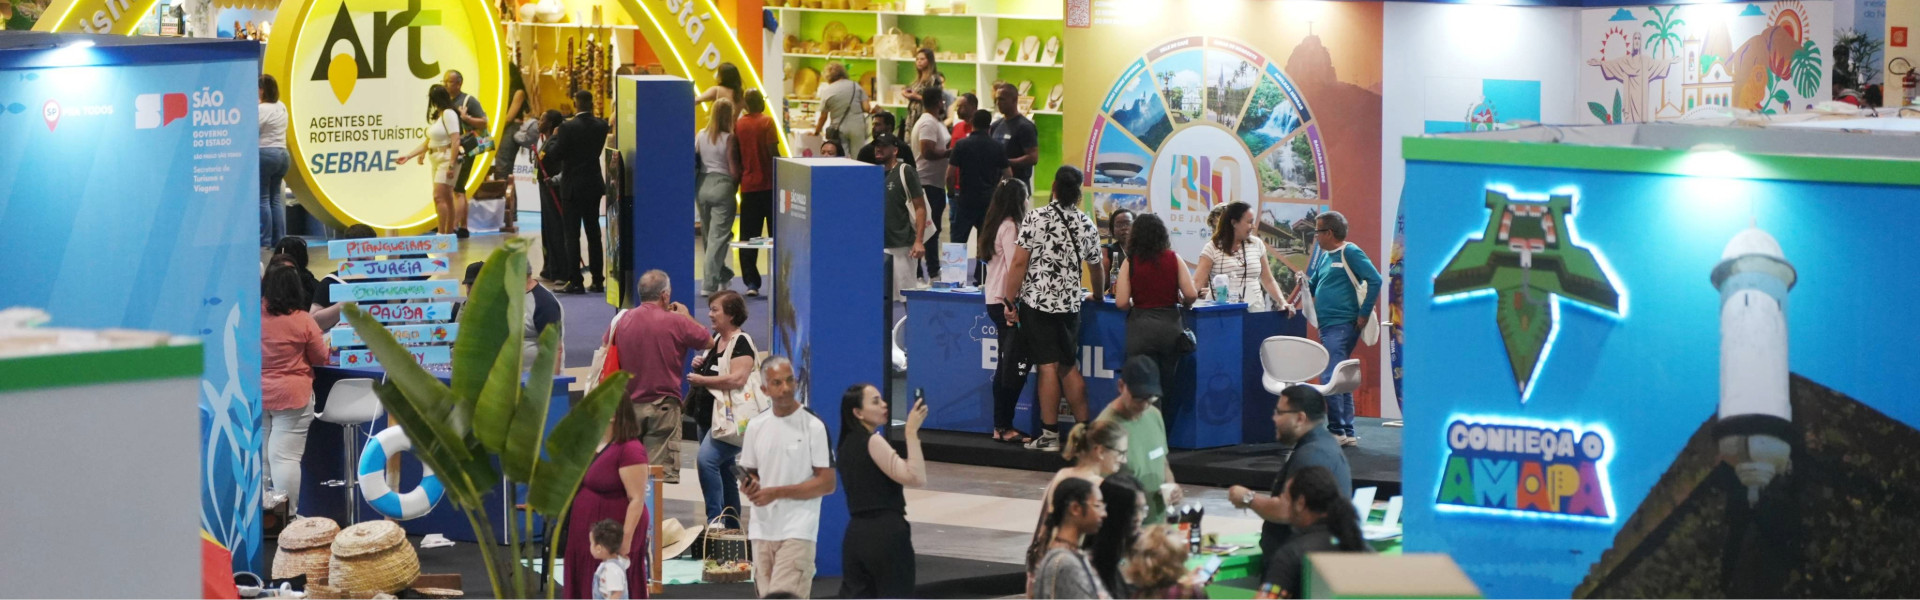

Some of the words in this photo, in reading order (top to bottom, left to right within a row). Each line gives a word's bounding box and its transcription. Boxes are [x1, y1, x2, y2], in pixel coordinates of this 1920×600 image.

[310, 0, 442, 81] Art
[192, 86, 224, 109] SÃO
[193, 108, 241, 127] PAULO
[310, 115, 365, 129] AGENTES
[367, 114, 383, 126] DE
[193, 130, 229, 139] GOVERNO
[193, 139, 204, 148] DO
[206, 138, 232, 148] ESTADO
[310, 129, 369, 143] ROTEIROS
[310, 150, 399, 174] SEBRAE
[1450, 423, 1575, 462] CONHEÇA
[1582, 434, 1603, 459] O
